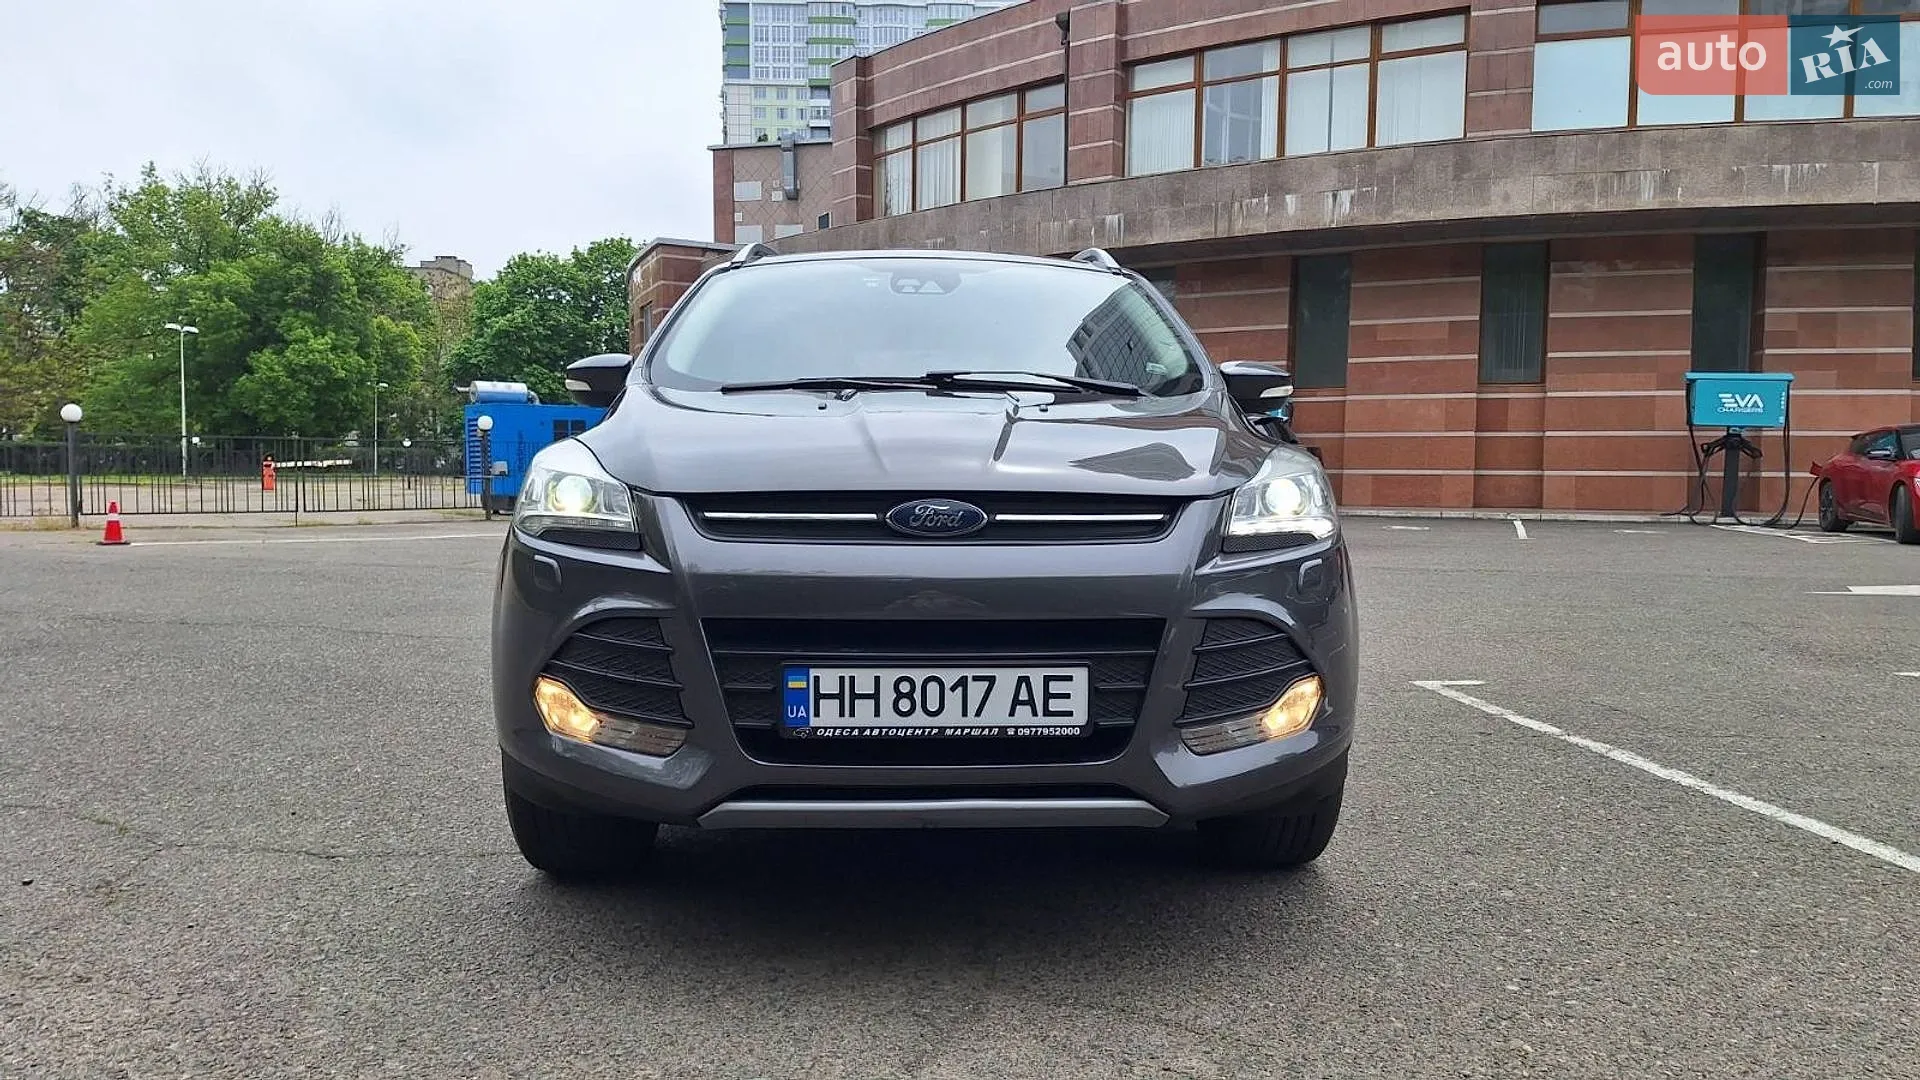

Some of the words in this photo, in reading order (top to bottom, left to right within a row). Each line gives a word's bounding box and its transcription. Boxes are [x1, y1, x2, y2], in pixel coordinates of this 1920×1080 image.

[1718, 393, 1764, 408] EVA
[909, 504, 965, 527] Ford
[892, 675, 997, 718] 8017
[1008, 675, 1074, 718] AE
[787, 705, 807, 718] UA
[816, 728, 859, 737] ОДЕСА
[863, 728, 939, 737] АВТОЦЕНТР
[944, 728, 999, 736] МАРШАЛ
[1017, 727, 1080, 736] 0977952000
